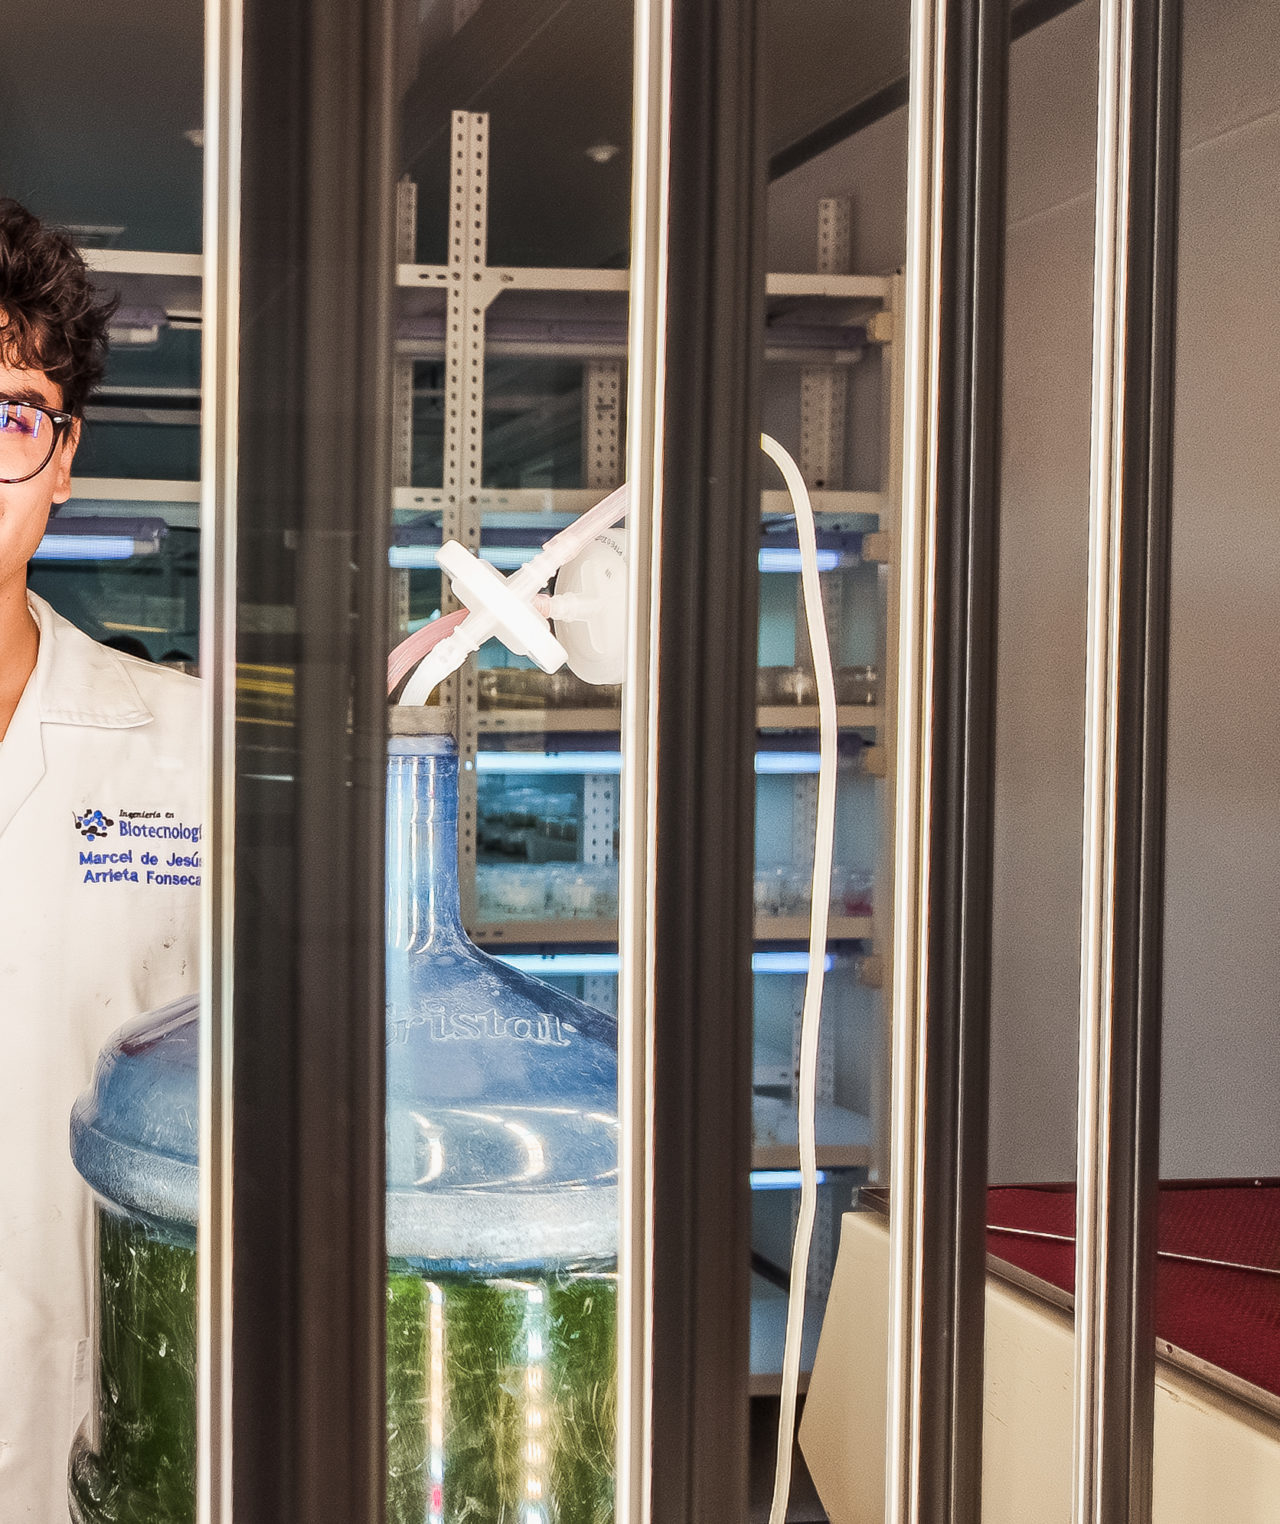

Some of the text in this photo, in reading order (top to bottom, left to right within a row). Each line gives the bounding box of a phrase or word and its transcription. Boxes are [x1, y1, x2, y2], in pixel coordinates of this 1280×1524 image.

[79, 850, 133, 866] Marcel
[140, 851, 159, 866] de
[83, 868, 201, 887] Arrieta Fonseca
